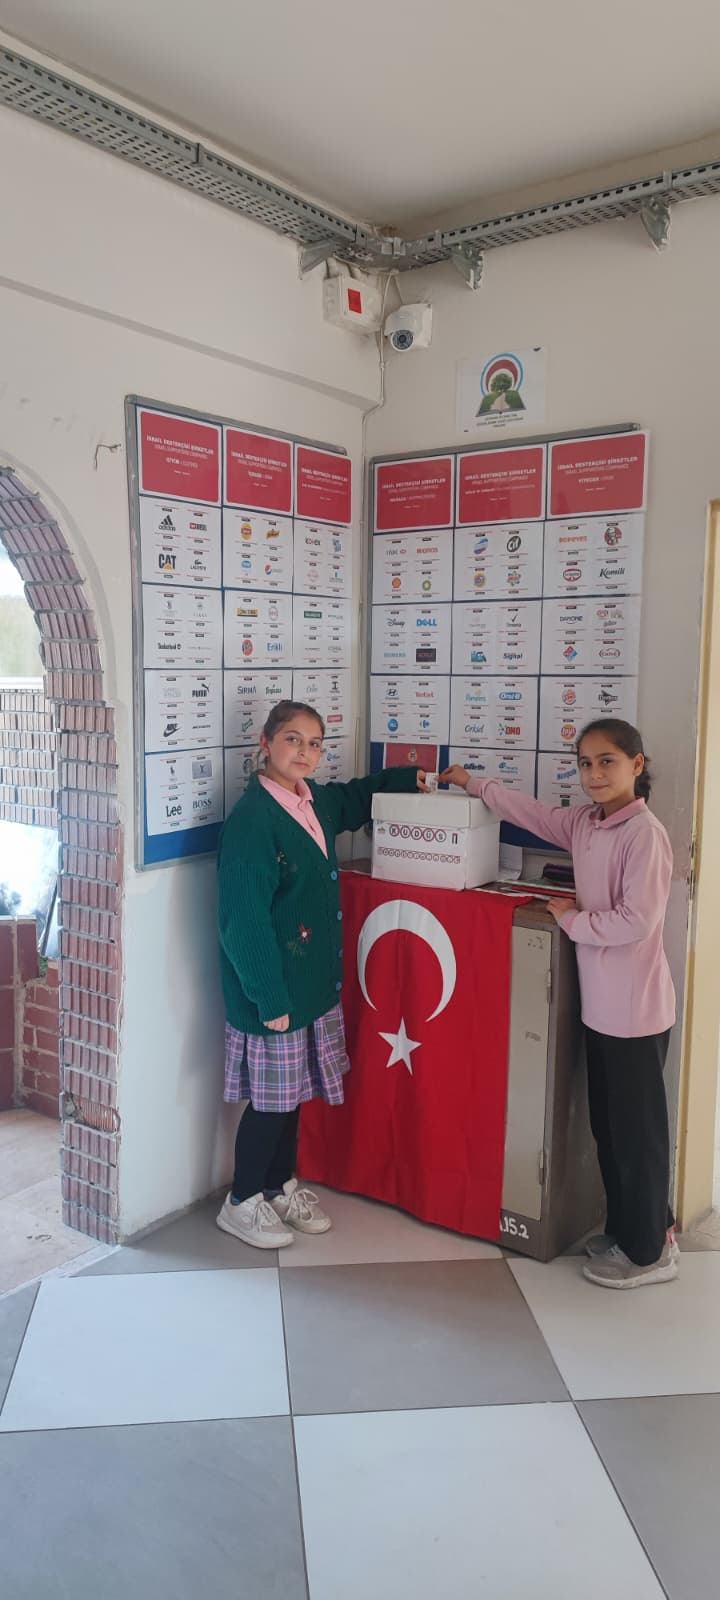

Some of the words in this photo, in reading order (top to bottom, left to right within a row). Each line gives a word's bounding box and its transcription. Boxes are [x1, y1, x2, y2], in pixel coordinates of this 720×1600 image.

[158, 553, 176, 570] CAT
[600, 568, 625, 580] Komili
[416, 618, 437, 627] DELL
[192, 798, 212, 809] BOSS
[166, 804, 182, 818] Lee
